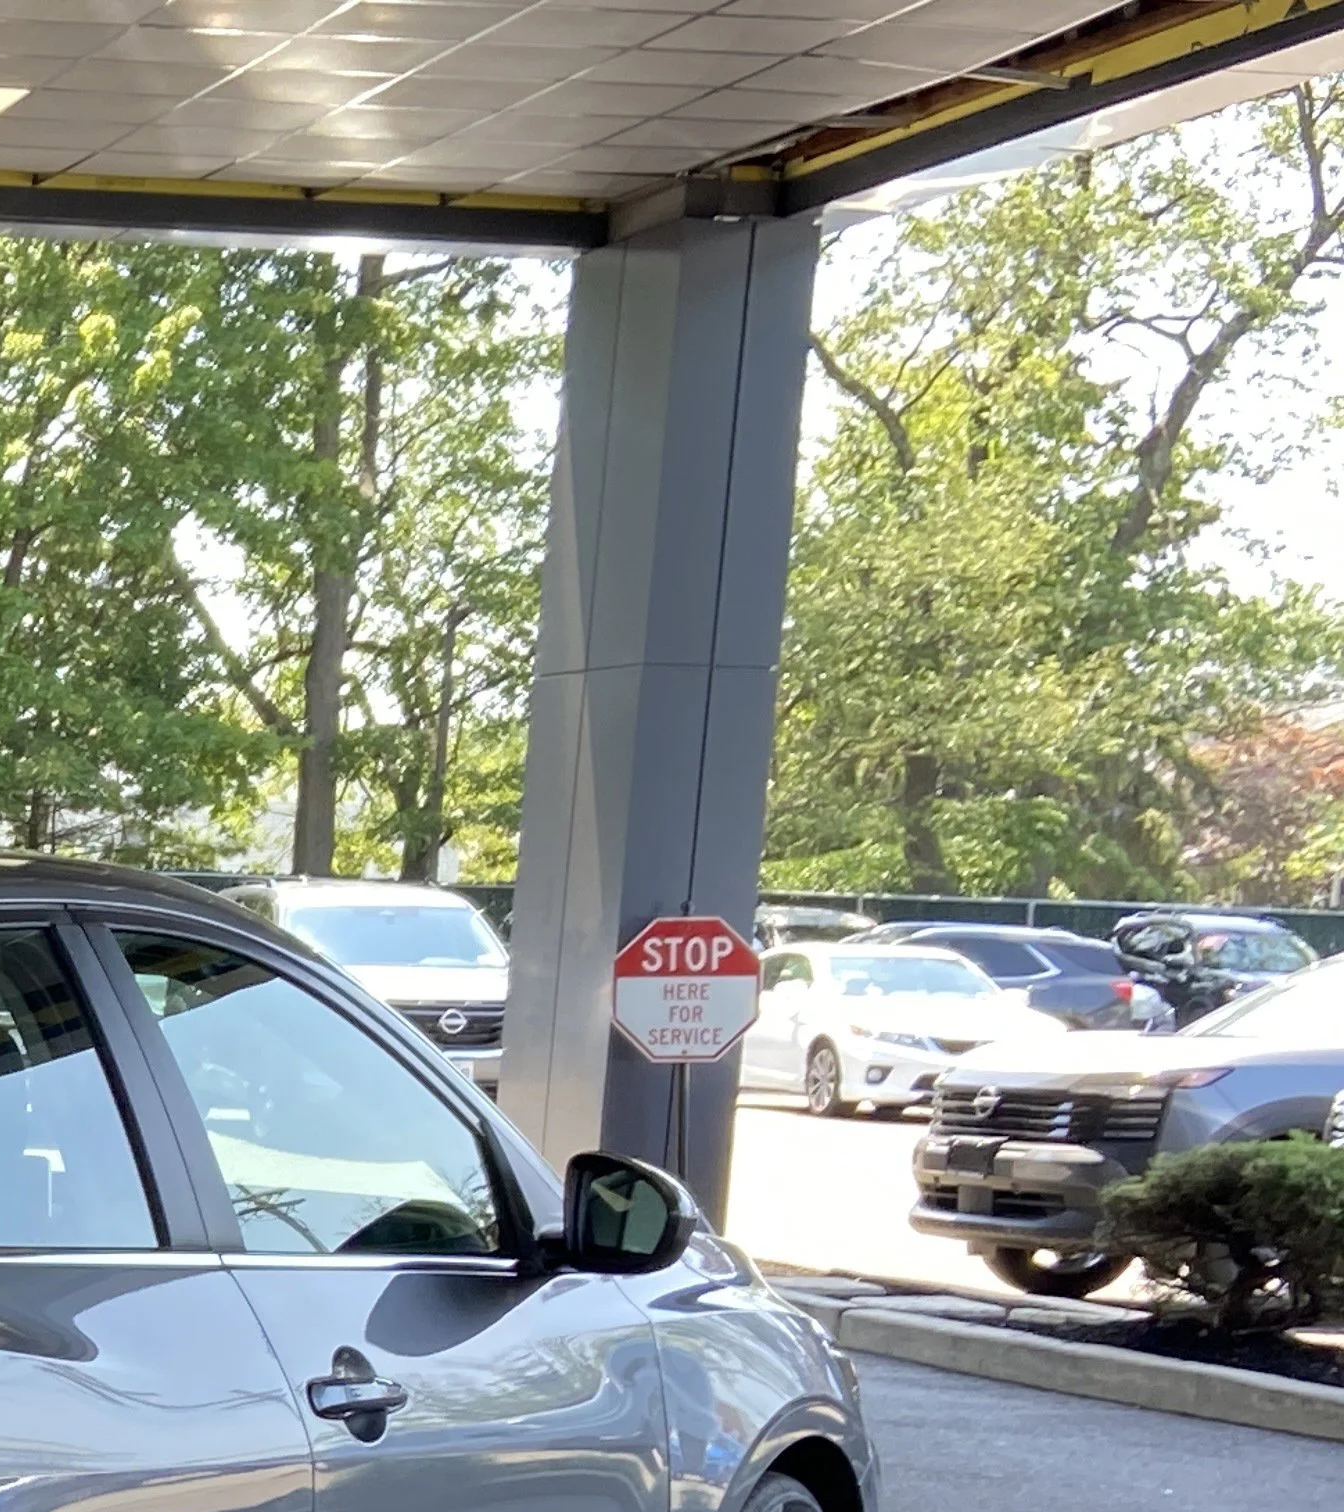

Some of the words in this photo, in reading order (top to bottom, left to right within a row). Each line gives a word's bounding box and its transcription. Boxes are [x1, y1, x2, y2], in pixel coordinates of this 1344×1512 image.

[641, 936, 734, 972] STOP
[662, 983, 710, 1001] HERE
[668, 1005, 703, 1023] FOR
[648, 1027, 723, 1046] SERVICE
